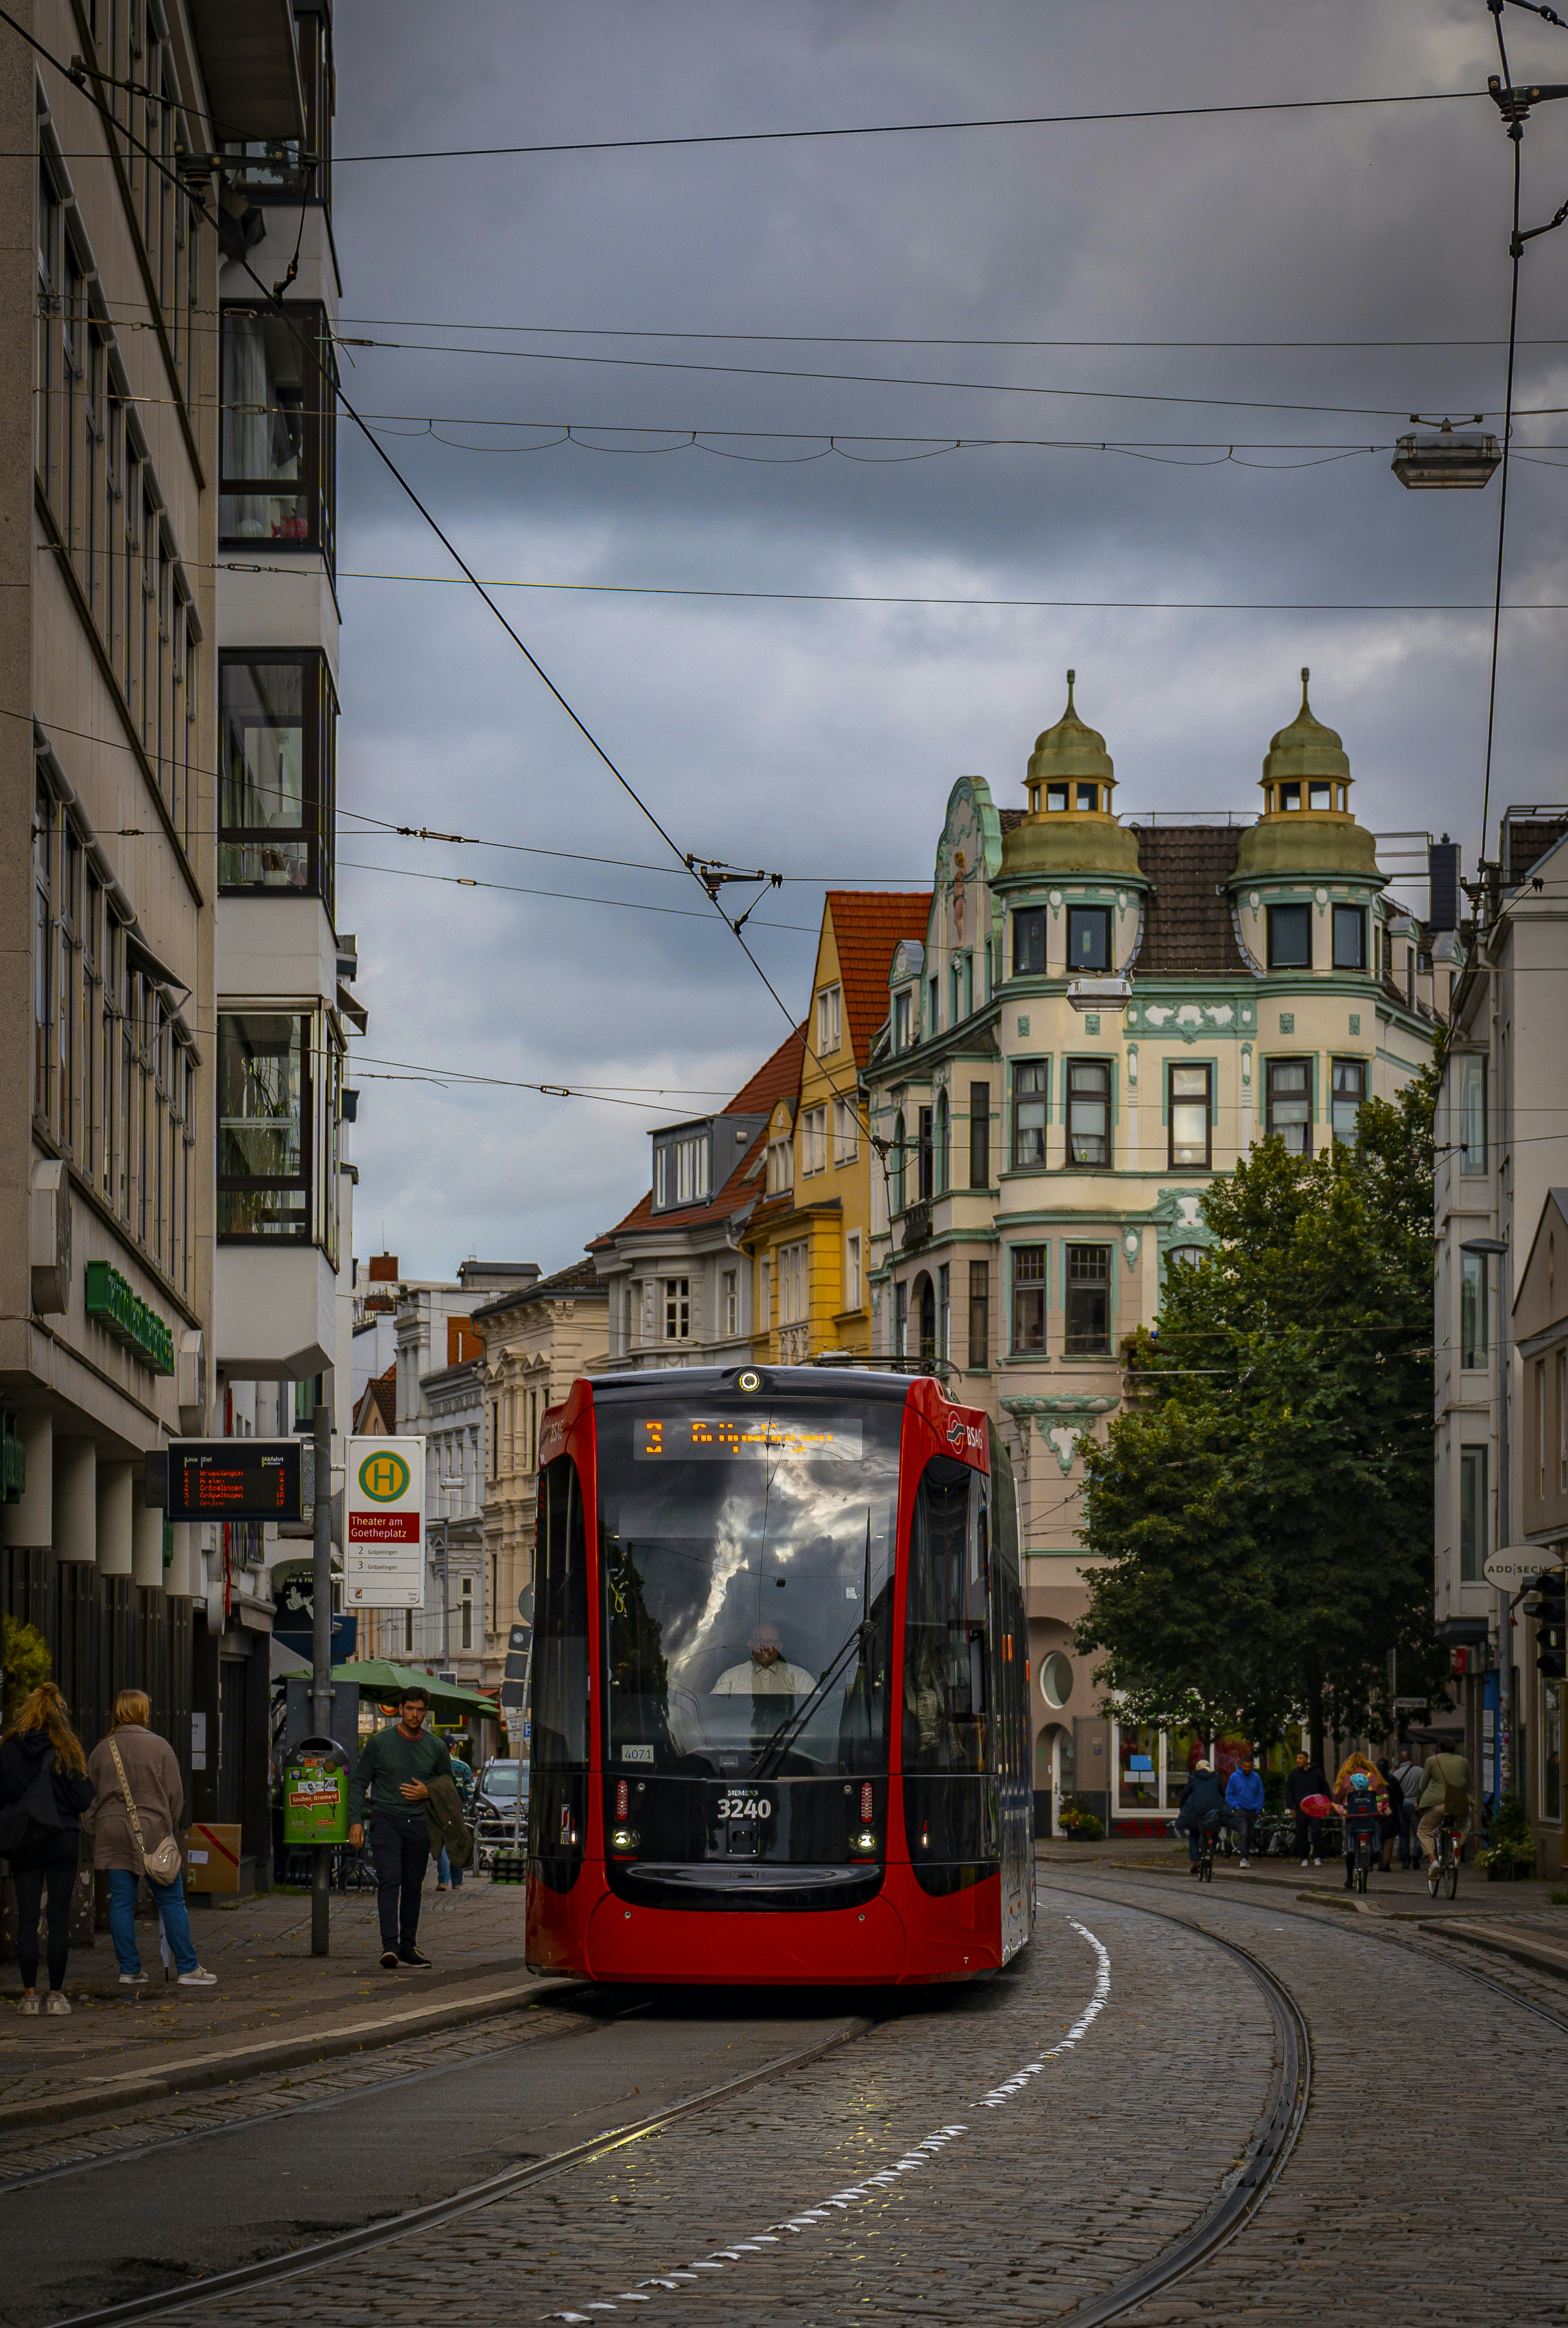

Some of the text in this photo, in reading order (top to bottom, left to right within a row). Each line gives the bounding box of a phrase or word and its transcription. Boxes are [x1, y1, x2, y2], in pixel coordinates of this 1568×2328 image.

[966, 1425, 983, 1449] BSAG
[351, 1516, 386, 1526] Theater
[351, 1528, 407, 1539] Goetheplatz
[358, 1546, 364, 1555] 2
[357, 1561, 363, 1569] 3
[1487, 1565, 1512, 1573] ADD
[625, 1750, 651, 1759] 4071
[717, 1799, 771, 1819] 3240
